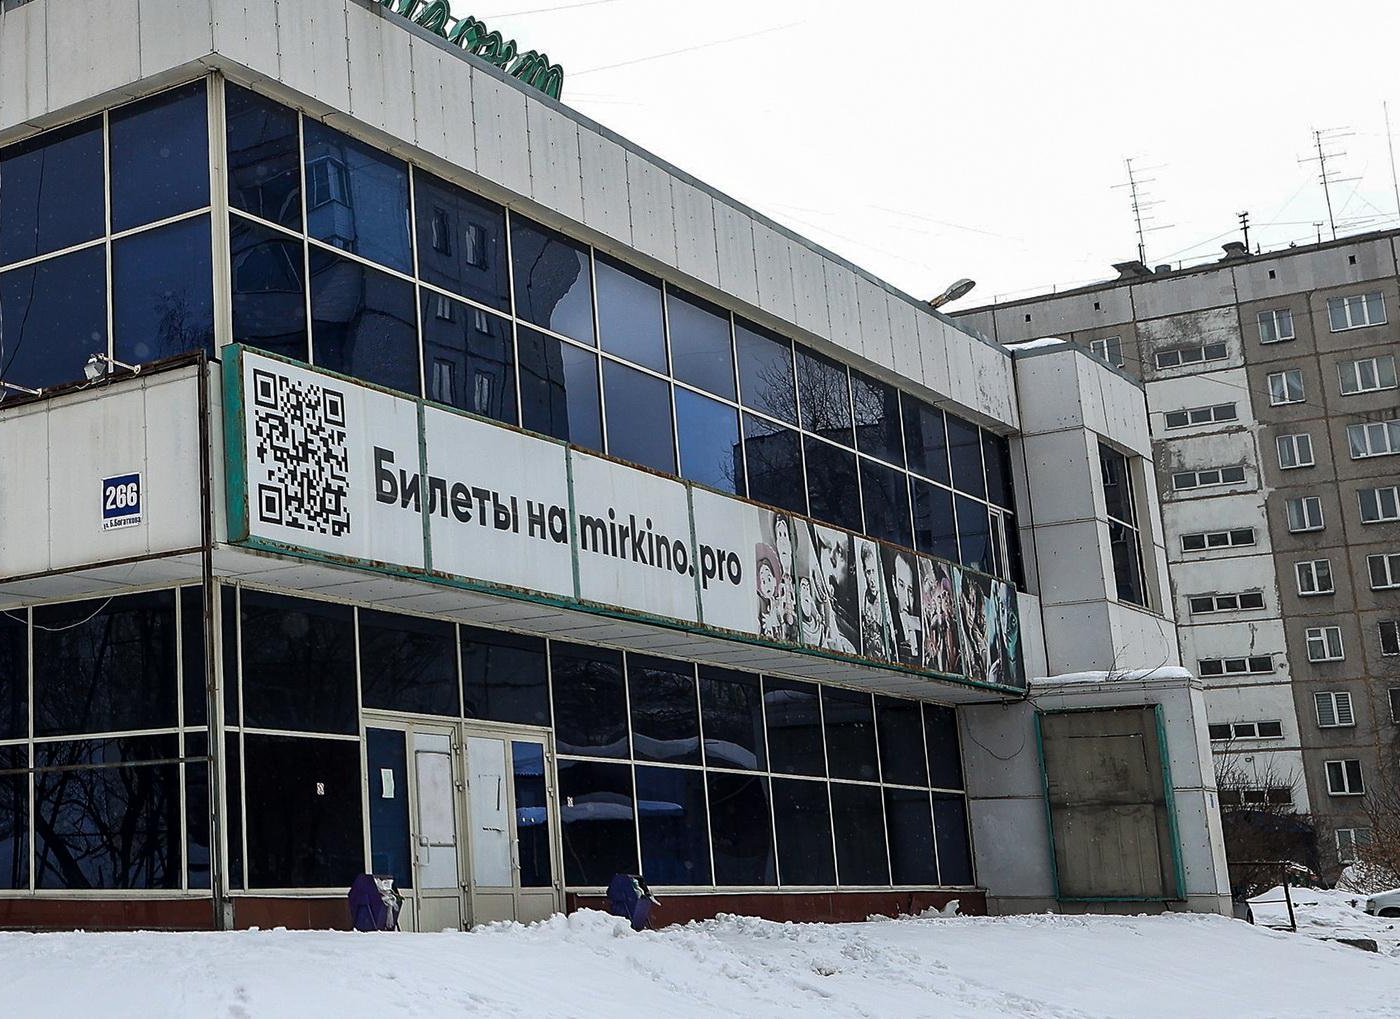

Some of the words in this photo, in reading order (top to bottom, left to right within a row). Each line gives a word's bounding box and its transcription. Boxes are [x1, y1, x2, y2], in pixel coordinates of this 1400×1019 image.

[105, 482, 138, 510] 266
[374, 446, 520, 534] Билеты
[526, 499, 569, 545] на
[579, 507, 743, 590] mirkino.pro
